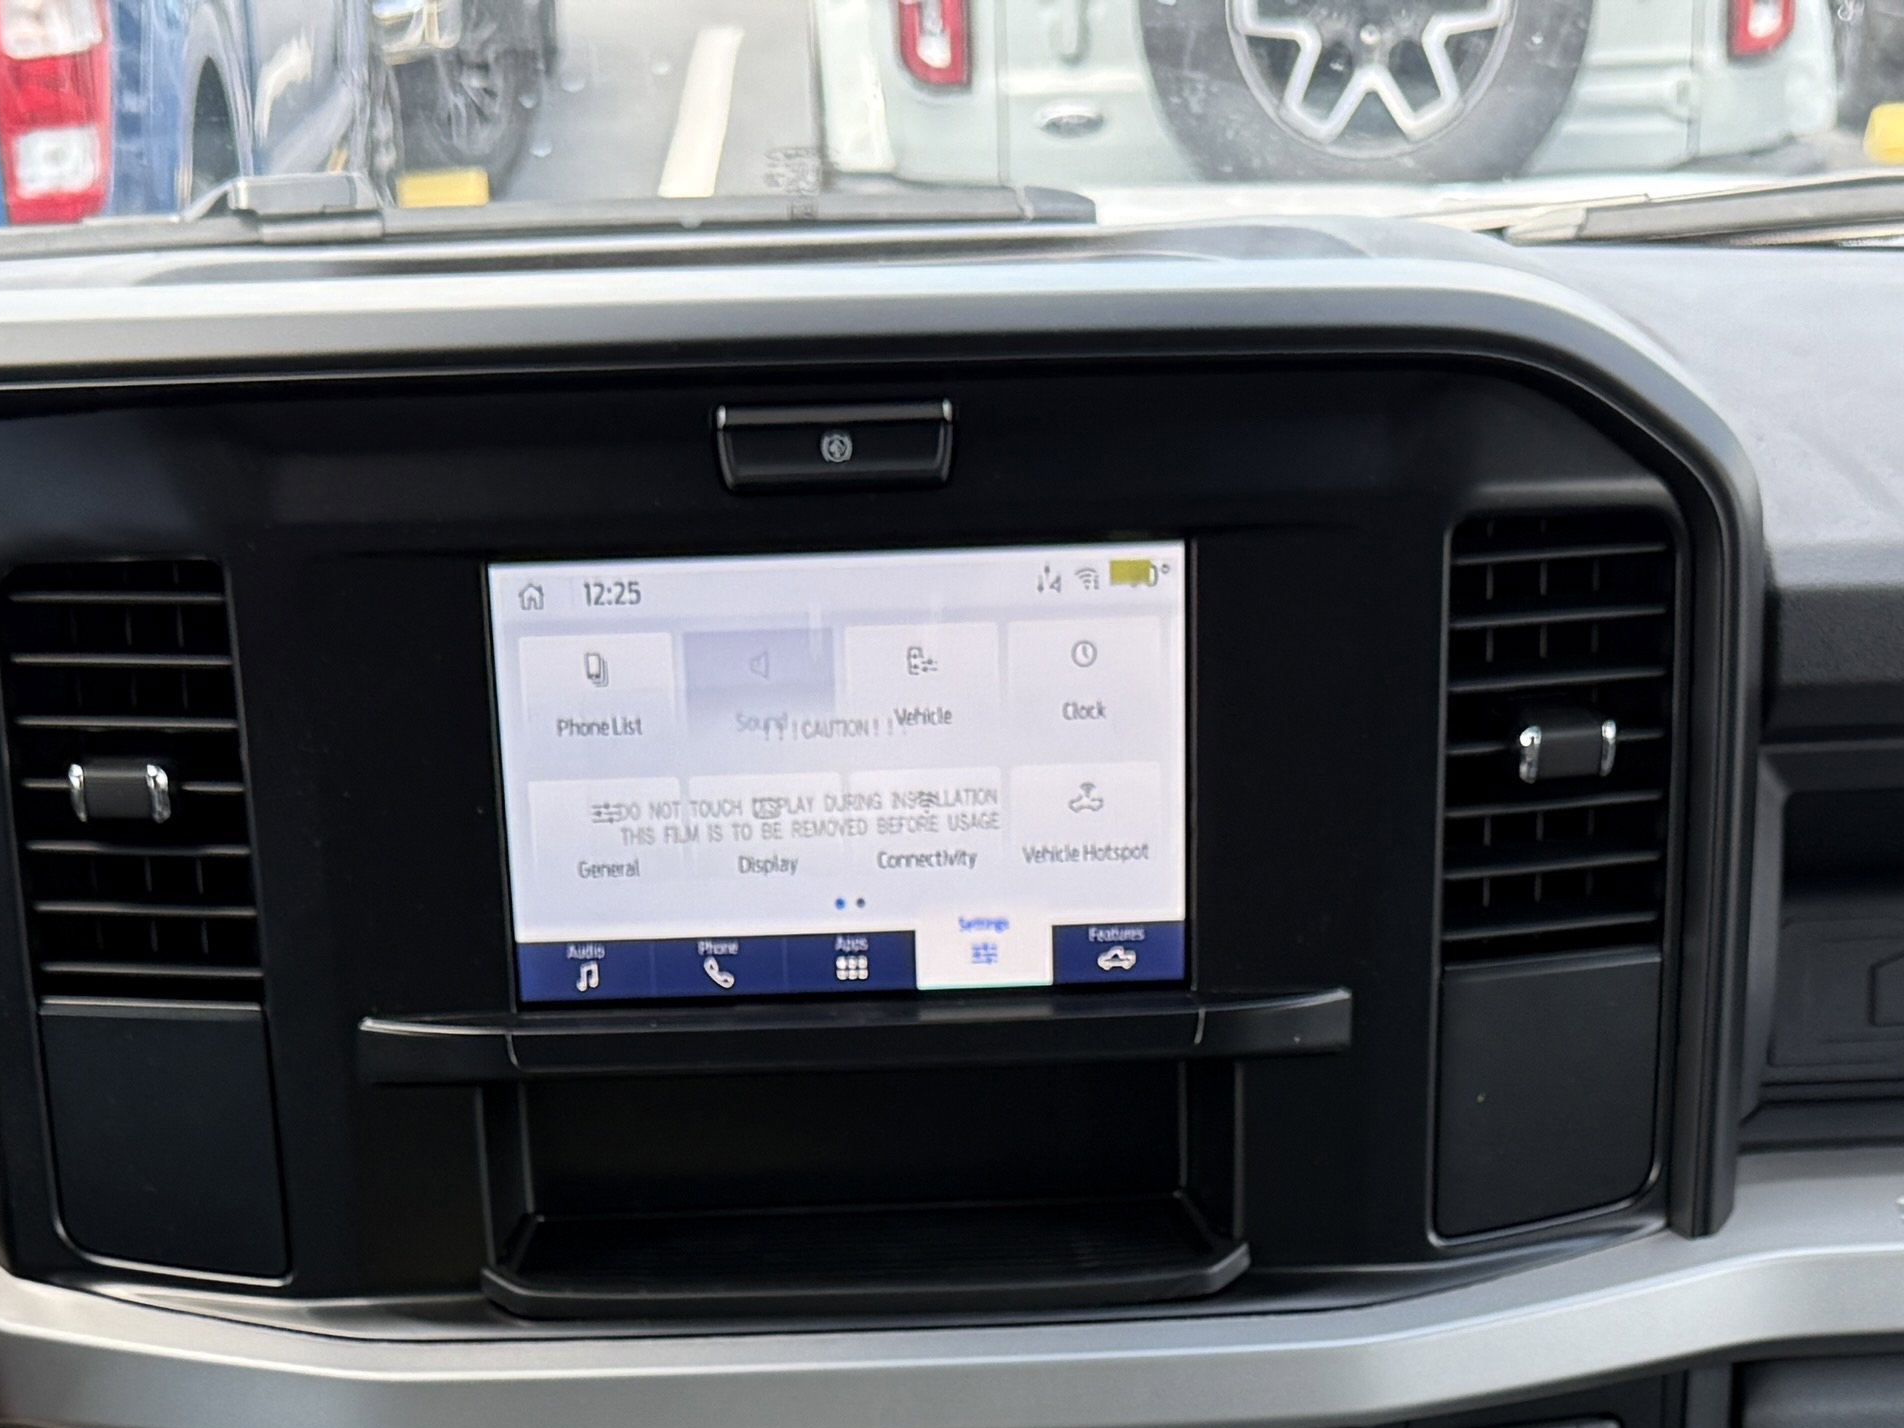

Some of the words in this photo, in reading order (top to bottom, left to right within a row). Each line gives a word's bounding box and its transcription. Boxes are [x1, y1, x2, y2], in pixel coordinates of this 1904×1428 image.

[583, 580, 642, 607] 12:25
[894, 706, 952, 727] Vehicle
[1062, 701, 1107, 721] Clock
[557, 717, 610, 736] Phone
[612, 717, 643, 736] List
[648, 800, 681, 821] NOT
[689, 798, 744, 819] TOUCH
[823, 792, 883, 814] DURING
[619, 826, 657, 847] THIS
[663, 824, 700, 845] FILM
[707, 823, 724, 844] IS
[731, 823, 753, 842] TO
[761, 820, 784, 841] BE
[790, 817, 868, 839] REMOVED
[876, 814, 939, 835] BEFORE
[946, 812, 1001, 832] USAGE
[876, 848, 978, 870] Connectivity
[1022, 843, 1080, 864] Vehicle
[1082, 842, 1149, 863] Hotspot
[577, 857, 641, 879] General
[737, 854, 799, 876] Display
[958, 915, 1009, 933] Settings
[1088, 927, 1146, 942] Features
[566, 943, 605, 960] Audio
[697, 939, 739, 956] Phone
[834, 935, 869, 953] Apps
